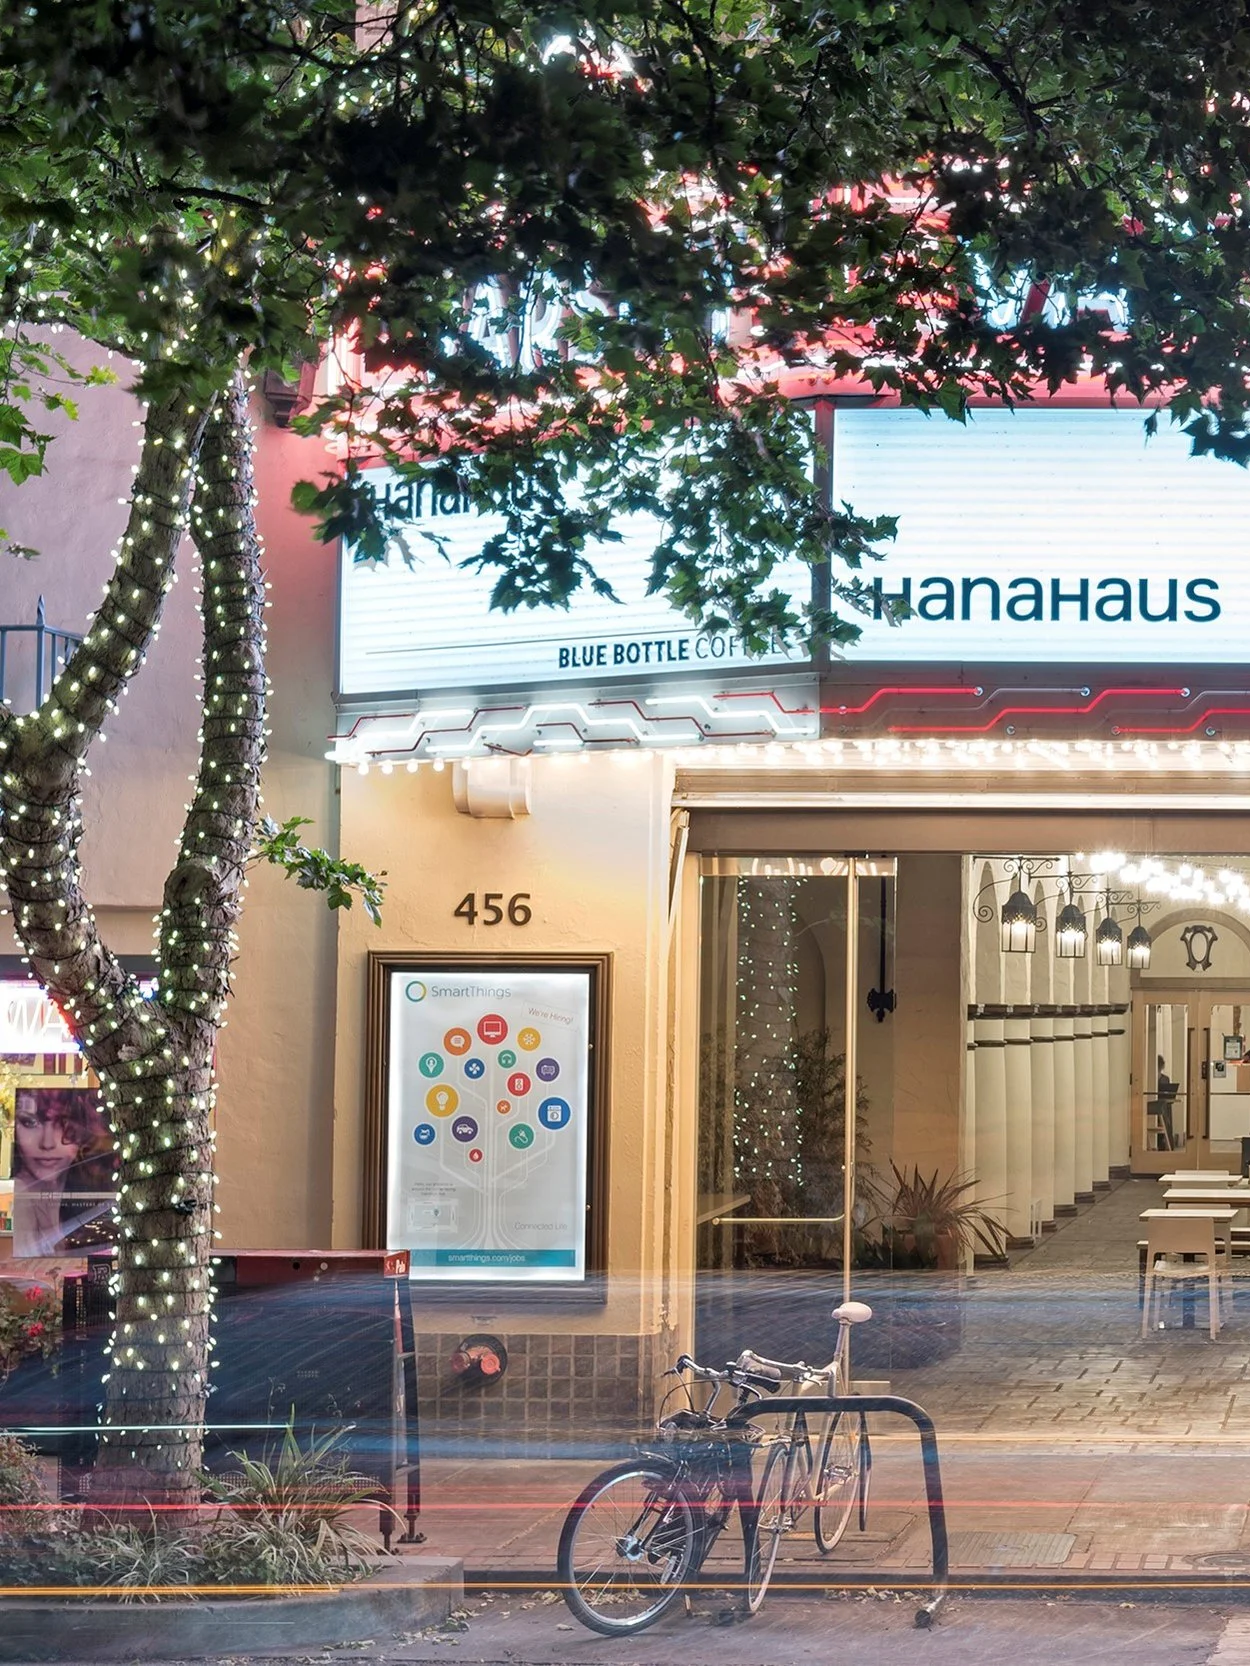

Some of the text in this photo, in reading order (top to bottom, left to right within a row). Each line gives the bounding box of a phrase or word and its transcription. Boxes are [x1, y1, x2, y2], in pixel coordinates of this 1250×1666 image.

[873, 577, 1221, 622] HanaHaus
[558, 644, 607, 669] BLUE
[613, 639, 690, 665] BOTTLE
[454, 893, 532, 926] 456
[431, 985, 512, 1000] SmartThings
[528, 1007, 574, 1025] We're Hiring!
[448, 1254, 526, 1264] smartthings.com/jobs
